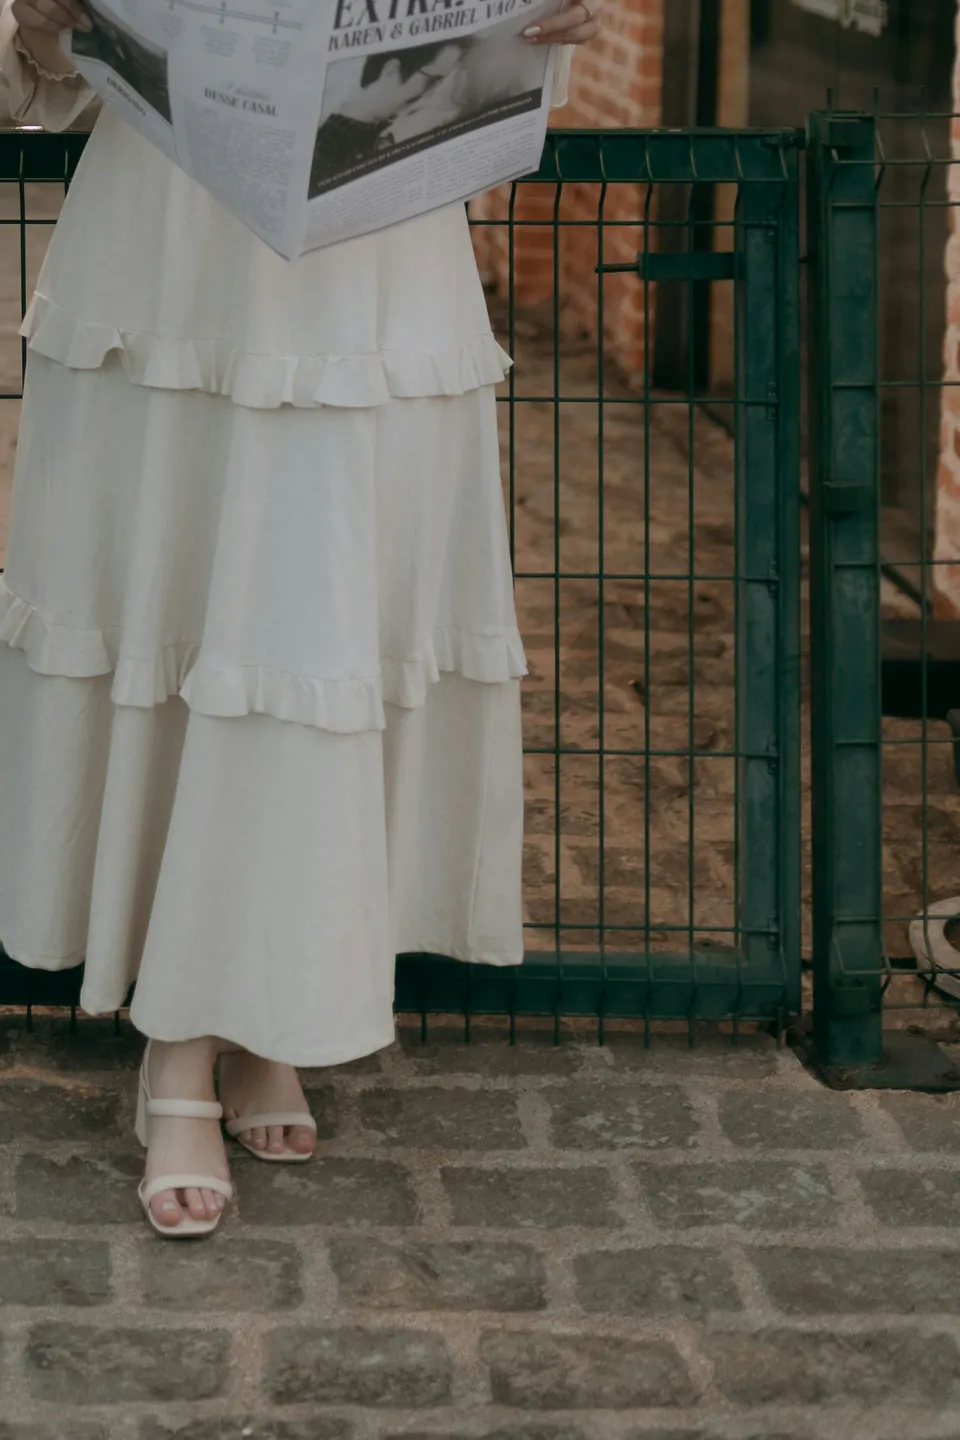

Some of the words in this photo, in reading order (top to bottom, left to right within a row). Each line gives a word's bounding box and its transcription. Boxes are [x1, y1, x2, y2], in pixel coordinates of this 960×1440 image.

[328, 27, 385, 51] KAREN
[390, 22, 403, 40] &
[409, 7, 480, 36] GABRIEL
